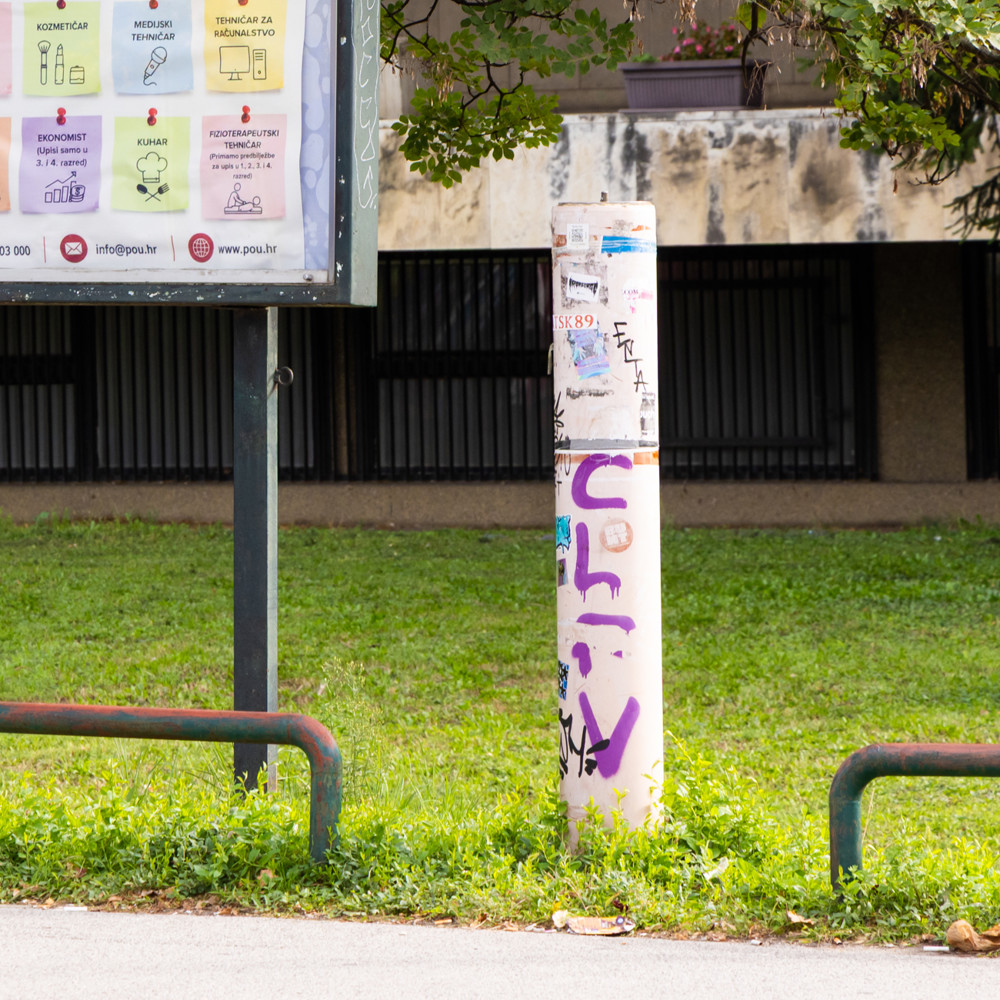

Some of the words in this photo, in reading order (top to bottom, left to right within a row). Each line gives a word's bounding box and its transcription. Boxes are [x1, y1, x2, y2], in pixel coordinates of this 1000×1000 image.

[134, 20, 172, 28] MEDIJSKI
[216, 15, 258, 25] TEHNIČAR
[261, 16, 273, 24] ZA
[36, 21, 88, 32] KOZMETIČAR
[132, 32, 176, 42] TEHNIČAR
[214, 28, 276, 38] RAČUNALSTVO
[38, 133, 86, 142] EKONOMIST
[209, 130, 280, 138] FIZIOTERAPEUTSKI
[137, 138, 168, 146] KUHAR
[224, 140, 262, 149] TEHNIČAR
[36, 146, 58, 156] (Upisi
[50, 158, 58, 166] 4.
[60, 158, 88, 168] razred)
[14, 246, 30, 256] 000
[96, 244, 158, 256] info@pou.hr
[218, 244, 278, 256] www.pou.hr
[574, 314, 594, 328] 89
